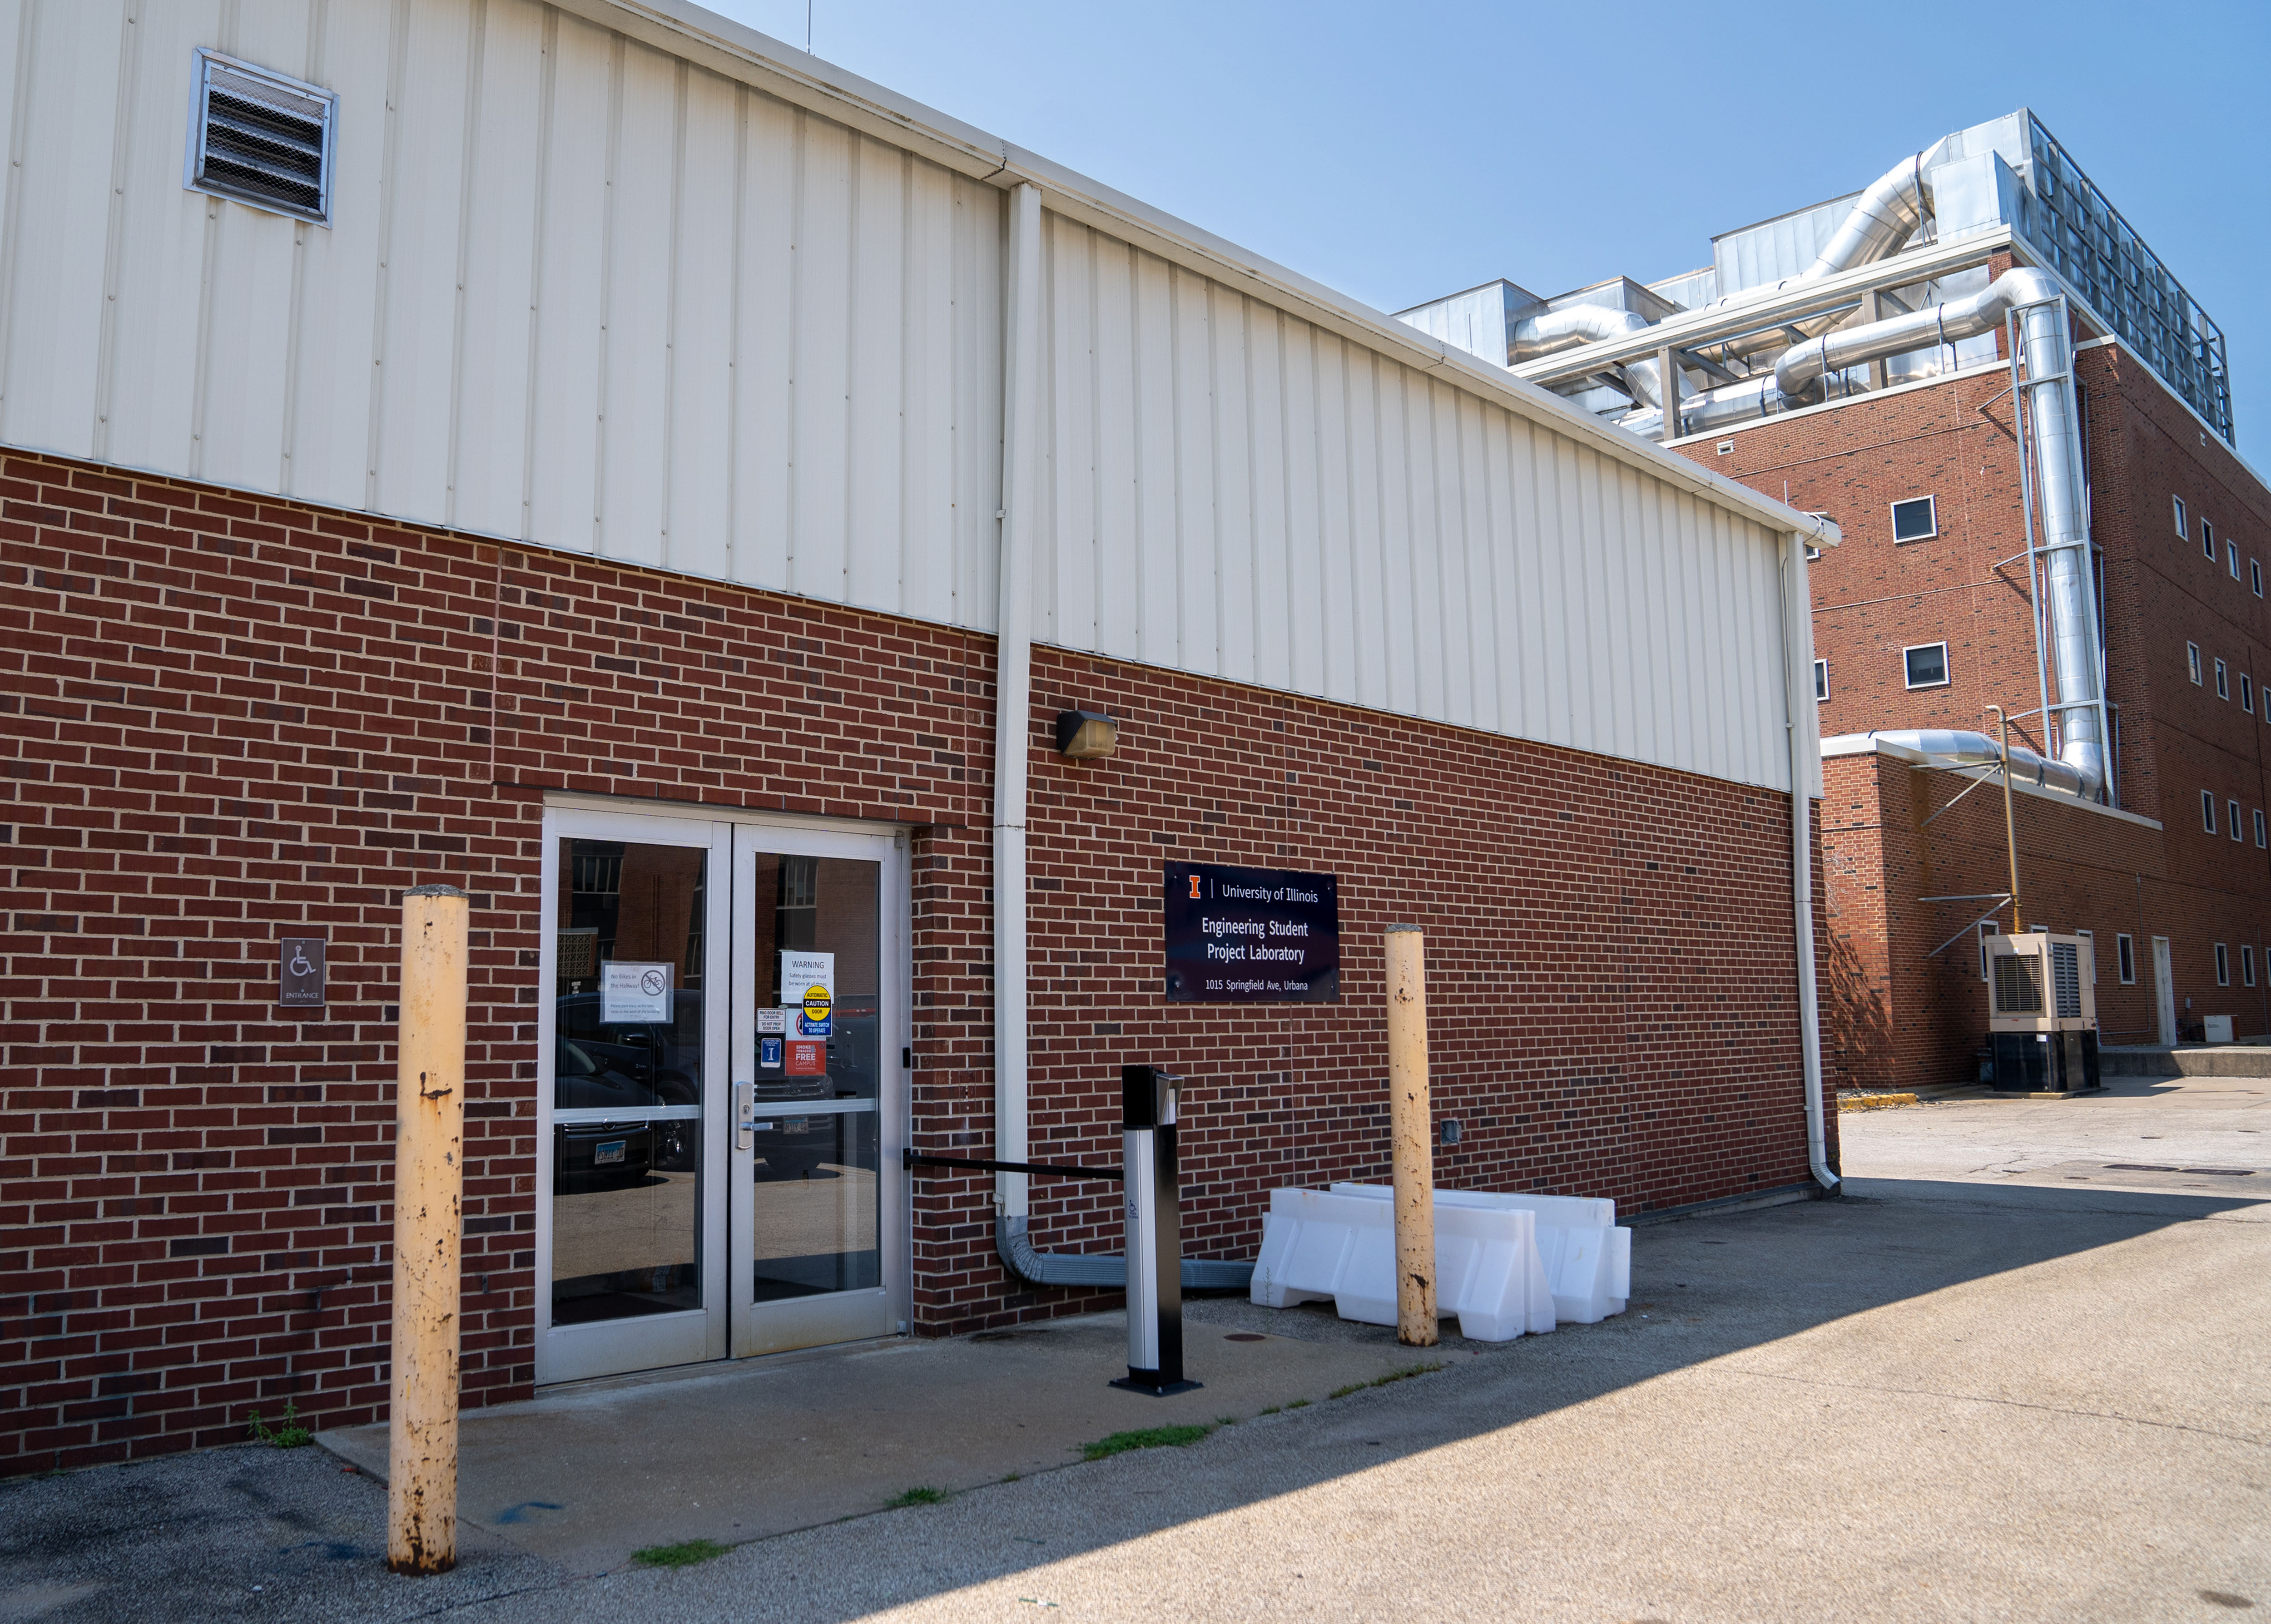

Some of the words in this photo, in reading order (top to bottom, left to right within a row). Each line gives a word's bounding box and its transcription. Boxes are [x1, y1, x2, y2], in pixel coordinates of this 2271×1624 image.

[1223, 884, 1272, 903] University
[1274, 887, 1284, 900] of
[1286, 888, 1318, 903] Illinois
[1202, 917, 1265, 939] Engineering
[1269, 920, 1308, 936] Student
[1207, 943, 1245, 963] Project
[1250, 944, 1304, 965] Laboratory
[792, 961, 824, 969] WARNING
[1205, 980, 1223, 990] 1015
[1226, 980, 1264, 992] Springfield
[1267, 980, 1281, 991] Ave,
[1284, 980, 1308, 990] Urbana
